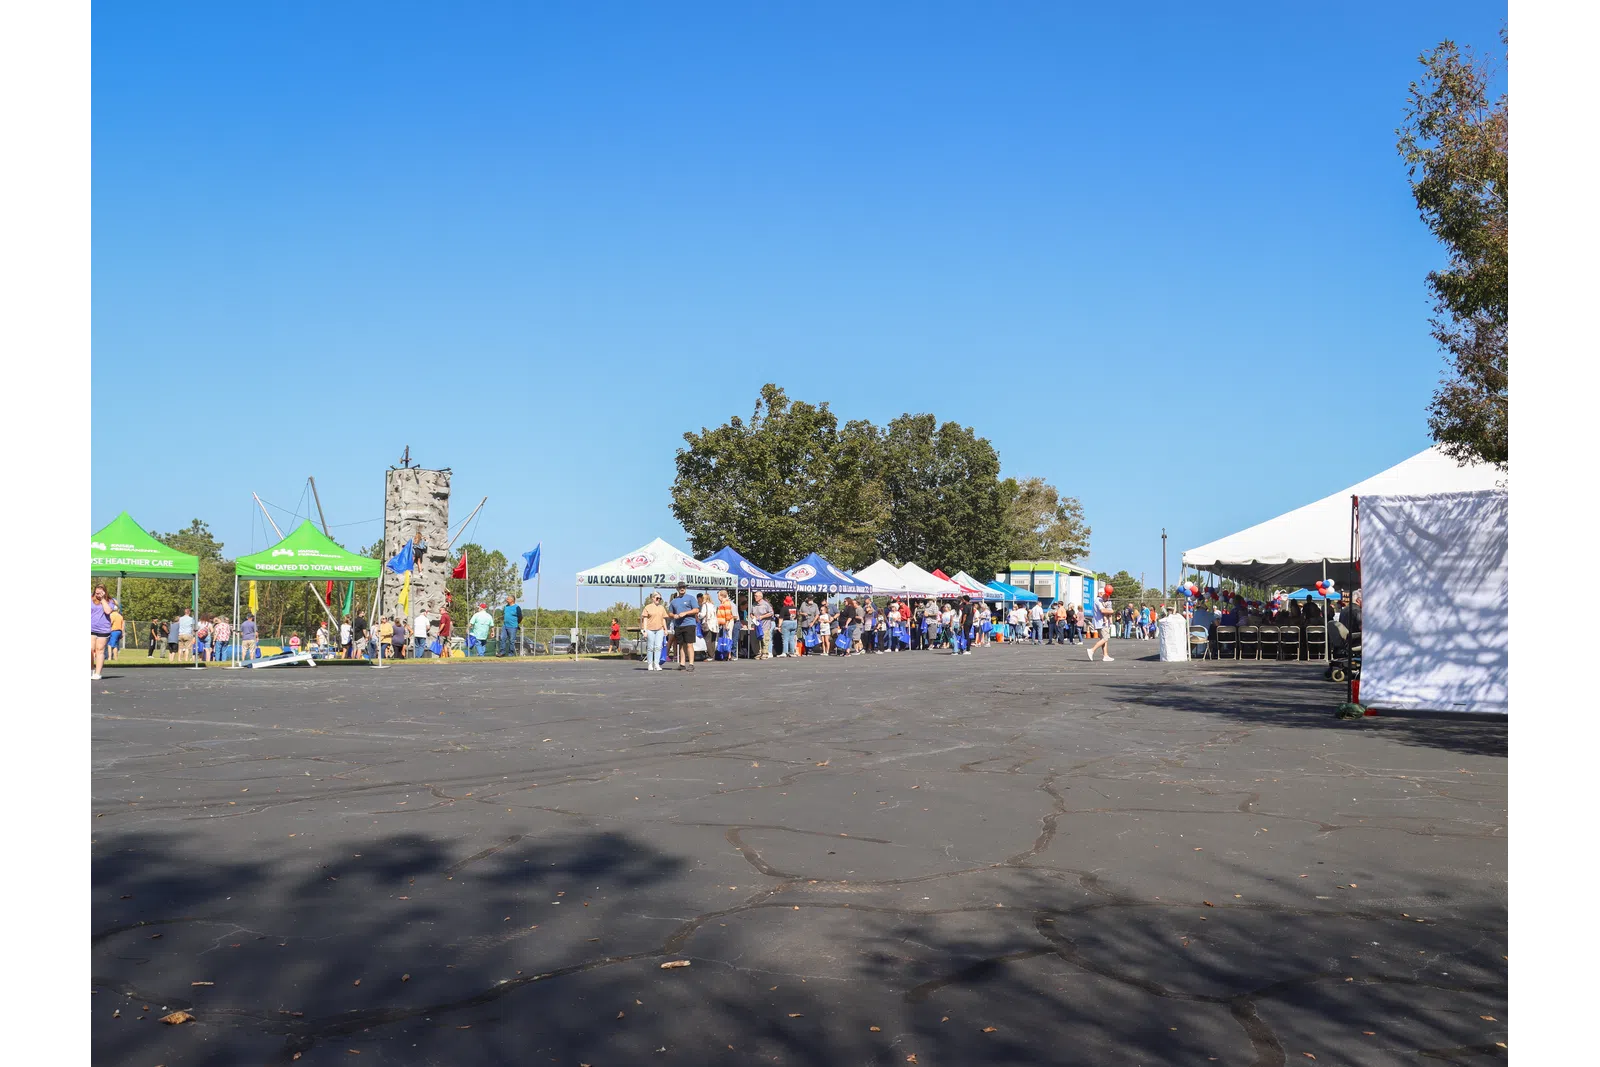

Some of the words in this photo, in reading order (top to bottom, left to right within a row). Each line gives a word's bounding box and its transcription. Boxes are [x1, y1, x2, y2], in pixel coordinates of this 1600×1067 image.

[105, 558, 150, 566] HEALTHIER
[587, 575, 599, 584] UA
[600, 575, 625, 584] LOCAL
[626, 574, 652, 584] UNION
[654, 574, 666, 583] 72
[686, 575, 694, 584] UA
[695, 575, 710, 585] LOCAL
[710, 576, 725, 586] UNION
[726, 577, 732, 586] 72
[787, 580, 793, 589] 72
[818, 584, 828, 592] 72
